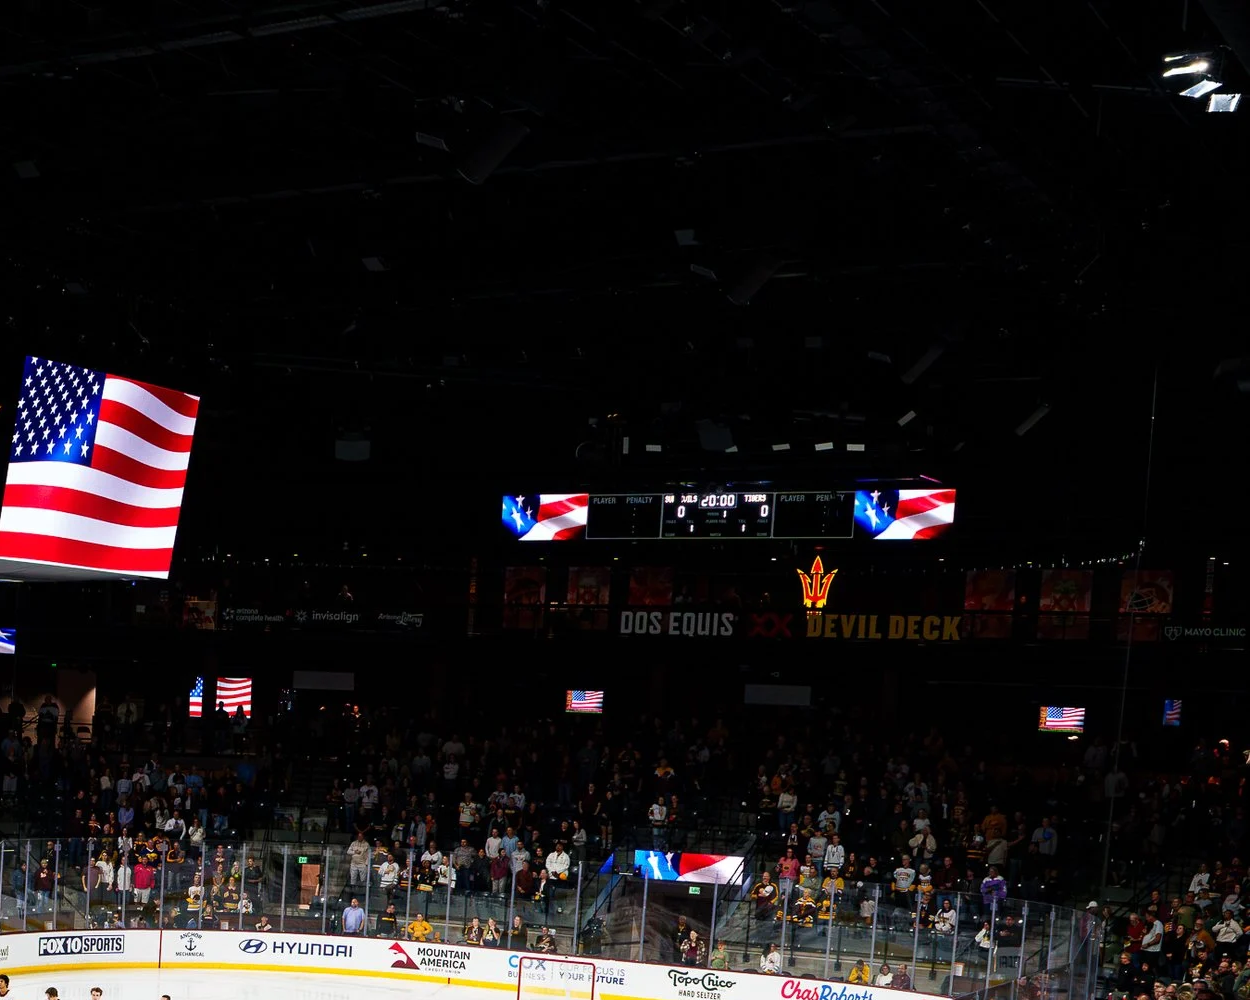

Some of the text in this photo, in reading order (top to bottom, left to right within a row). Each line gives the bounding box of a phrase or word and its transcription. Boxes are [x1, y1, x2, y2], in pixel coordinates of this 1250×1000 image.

[700, 494, 735, 506] 20:00
[677, 505, 686, 518] 0
[760, 504, 769, 517] 0
[312, 609, 359, 624] invisalign
[620, 611, 662, 635] DOS
[668, 612, 735, 638] EQUIS
[806, 613, 882, 640] DEVIL
[888, 615, 962, 641] DECK
[1184, 628, 1247, 637] MAYO CLINIC
[83, 935, 124, 954] SPORTS
[272, 941, 352, 958] HYUNDAI
[417, 947, 470, 960] MOUNTAIN
[420, 958, 467, 970] AMERICA
[617, 968, 625, 977] IS
[668, 969, 737, 990] Topo Chico
[696, 991, 721, 1000] SELTZER
